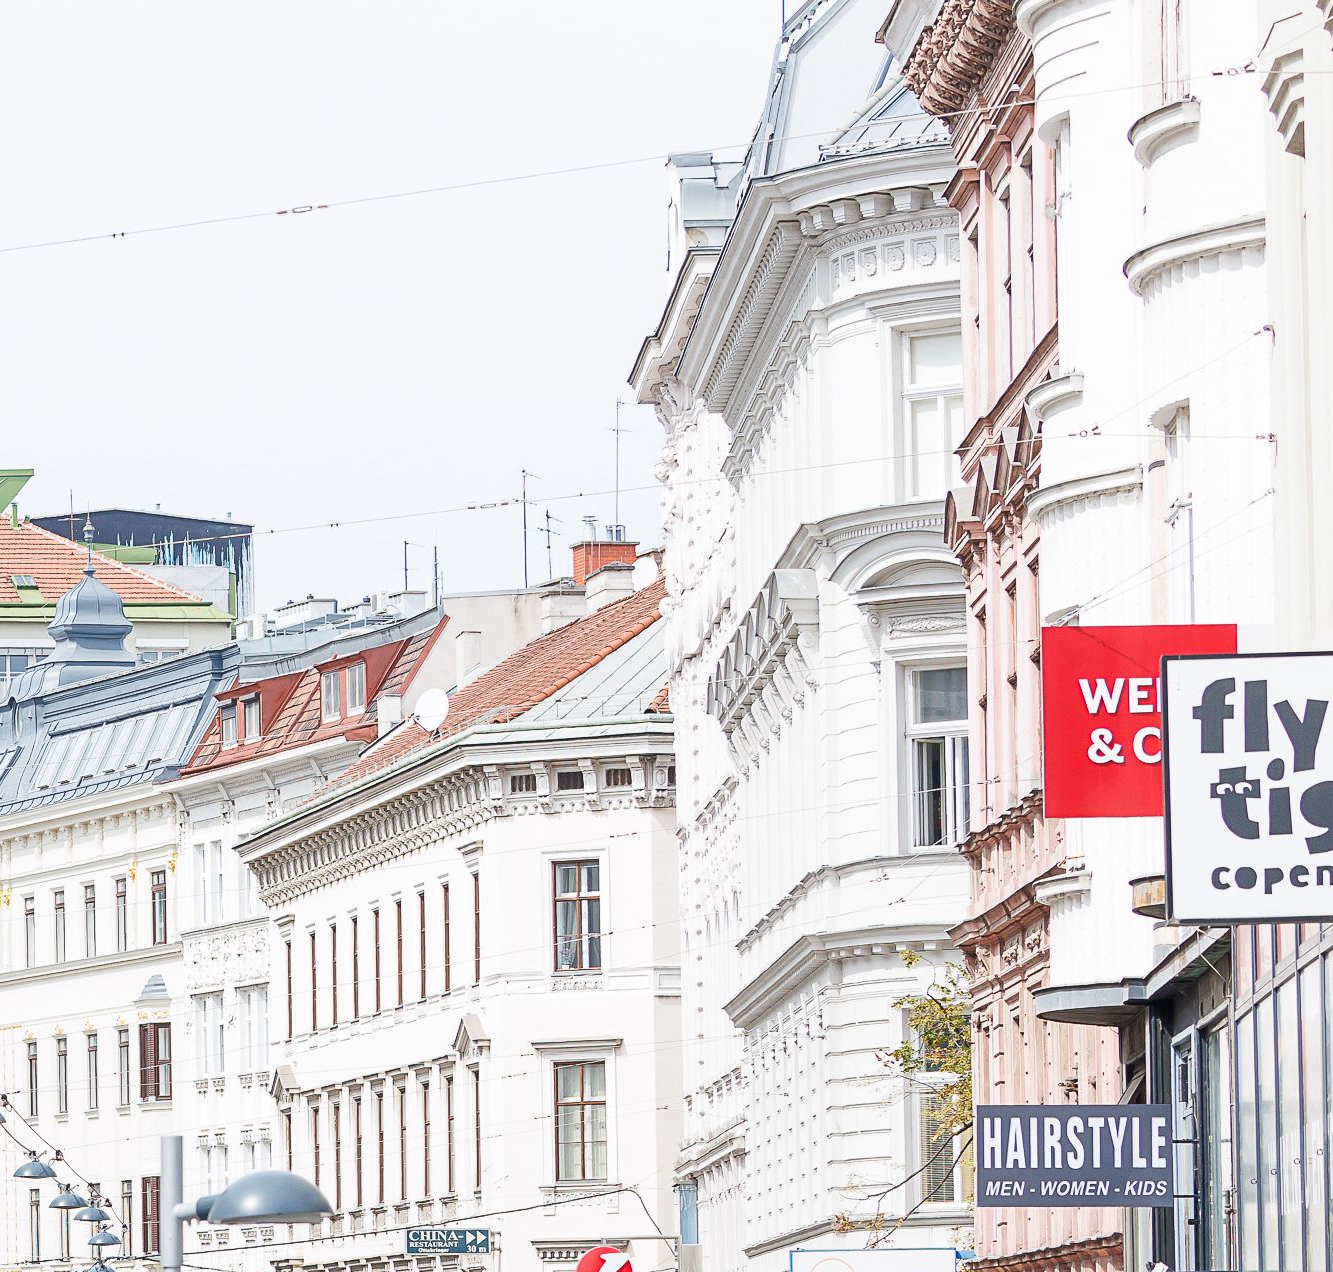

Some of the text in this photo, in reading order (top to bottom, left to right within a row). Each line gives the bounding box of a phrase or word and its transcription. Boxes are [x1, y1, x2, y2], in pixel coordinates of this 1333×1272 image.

[1078, 678, 1162, 714] WE
[1087, 726, 1162, 764] & C
[1211, 865, 1333, 894] copen
[983, 1116, 1167, 1170] HAIRSTYLE
[985, 1181, 1025, 1197] MEN
[1040, 1181, 1109, 1197] WOMEN
[1124, 1181, 1167, 1197] KIDS
[408, 1231, 463, 1241] CHINA-
[466, 1245, 476, 1253] 30
